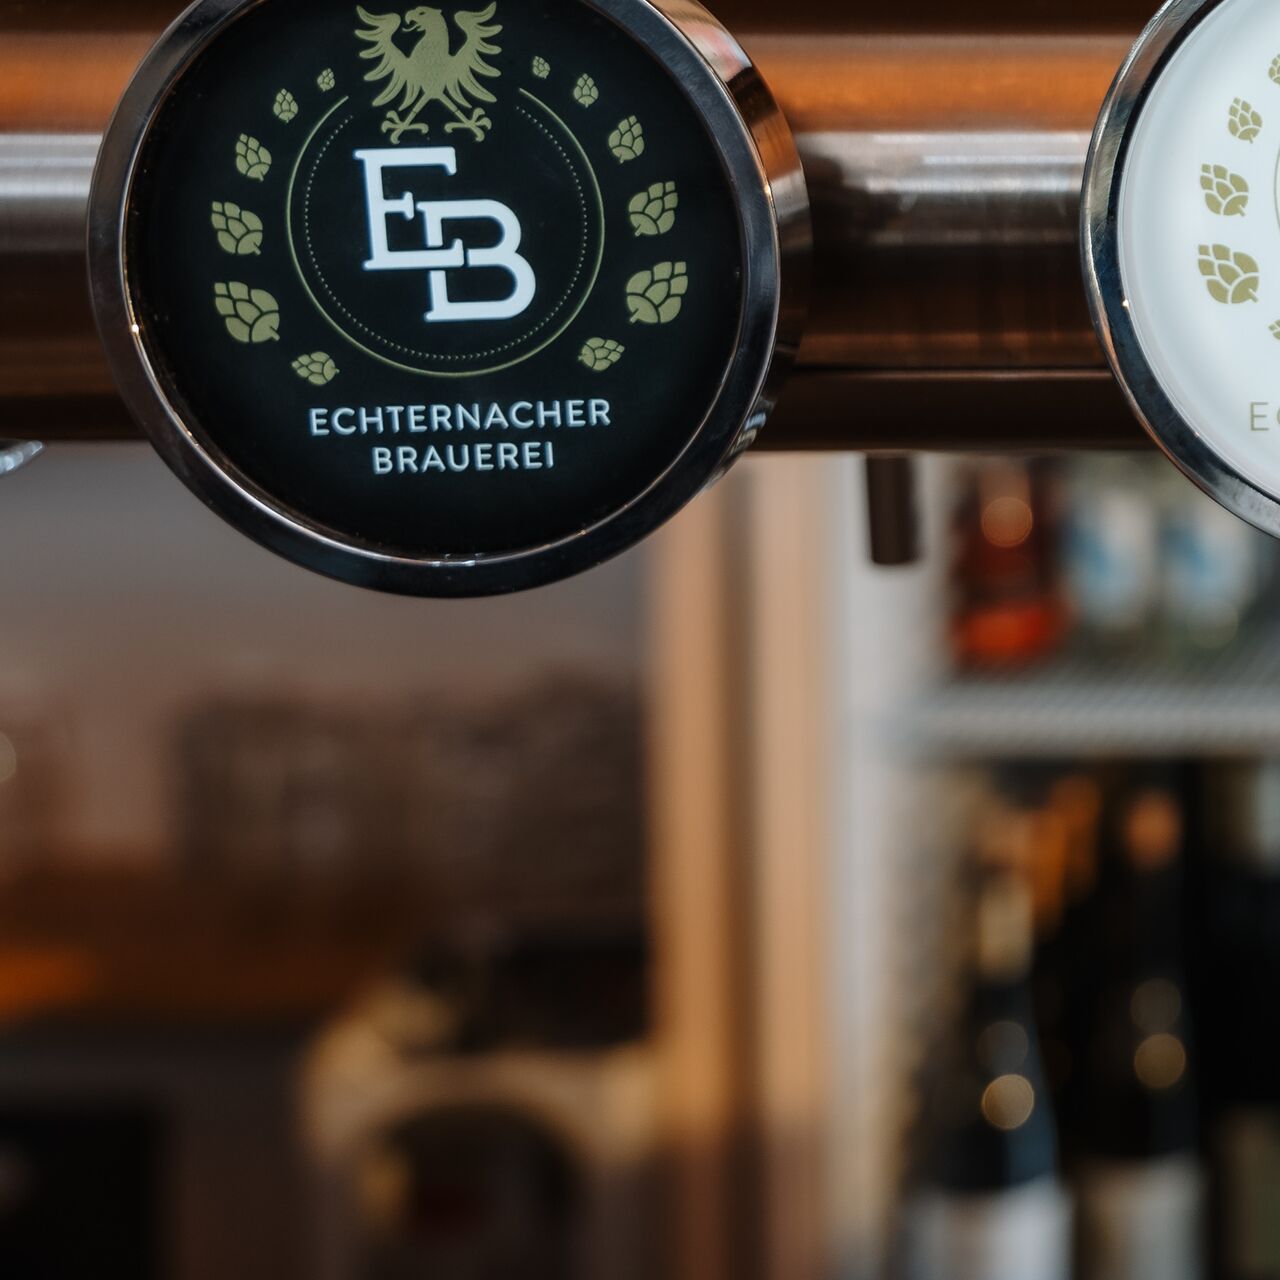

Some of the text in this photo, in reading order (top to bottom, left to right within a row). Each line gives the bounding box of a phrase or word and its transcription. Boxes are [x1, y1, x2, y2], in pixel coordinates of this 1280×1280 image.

[353, 146, 536, 322] EB
[309, 398, 612, 437] ECHTERNACHER
[373, 441, 555, 475] BRAUEREI
